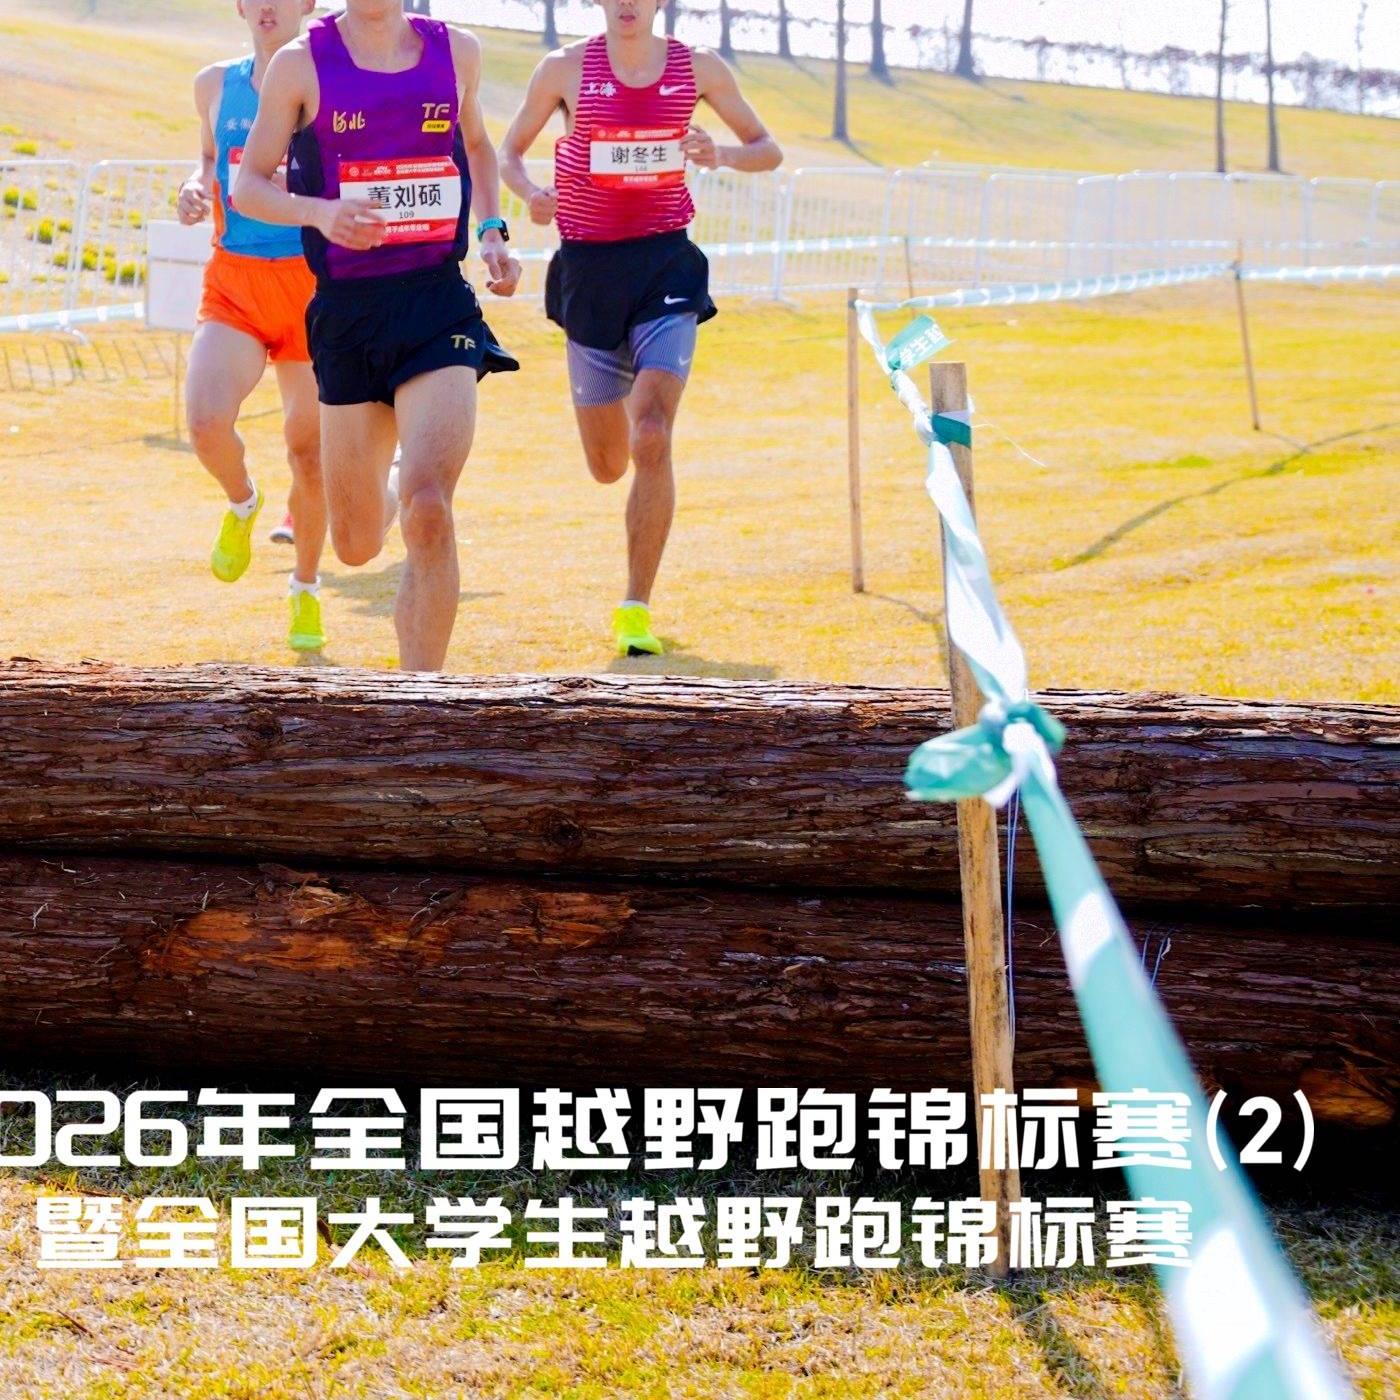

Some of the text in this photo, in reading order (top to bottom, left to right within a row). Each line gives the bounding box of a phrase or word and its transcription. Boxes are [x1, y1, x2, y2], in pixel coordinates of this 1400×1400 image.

[421, 103, 451, 119] TF
[611, 145, 668, 164] 谢冬生
[367, 183, 442, 210] 董刘硕
